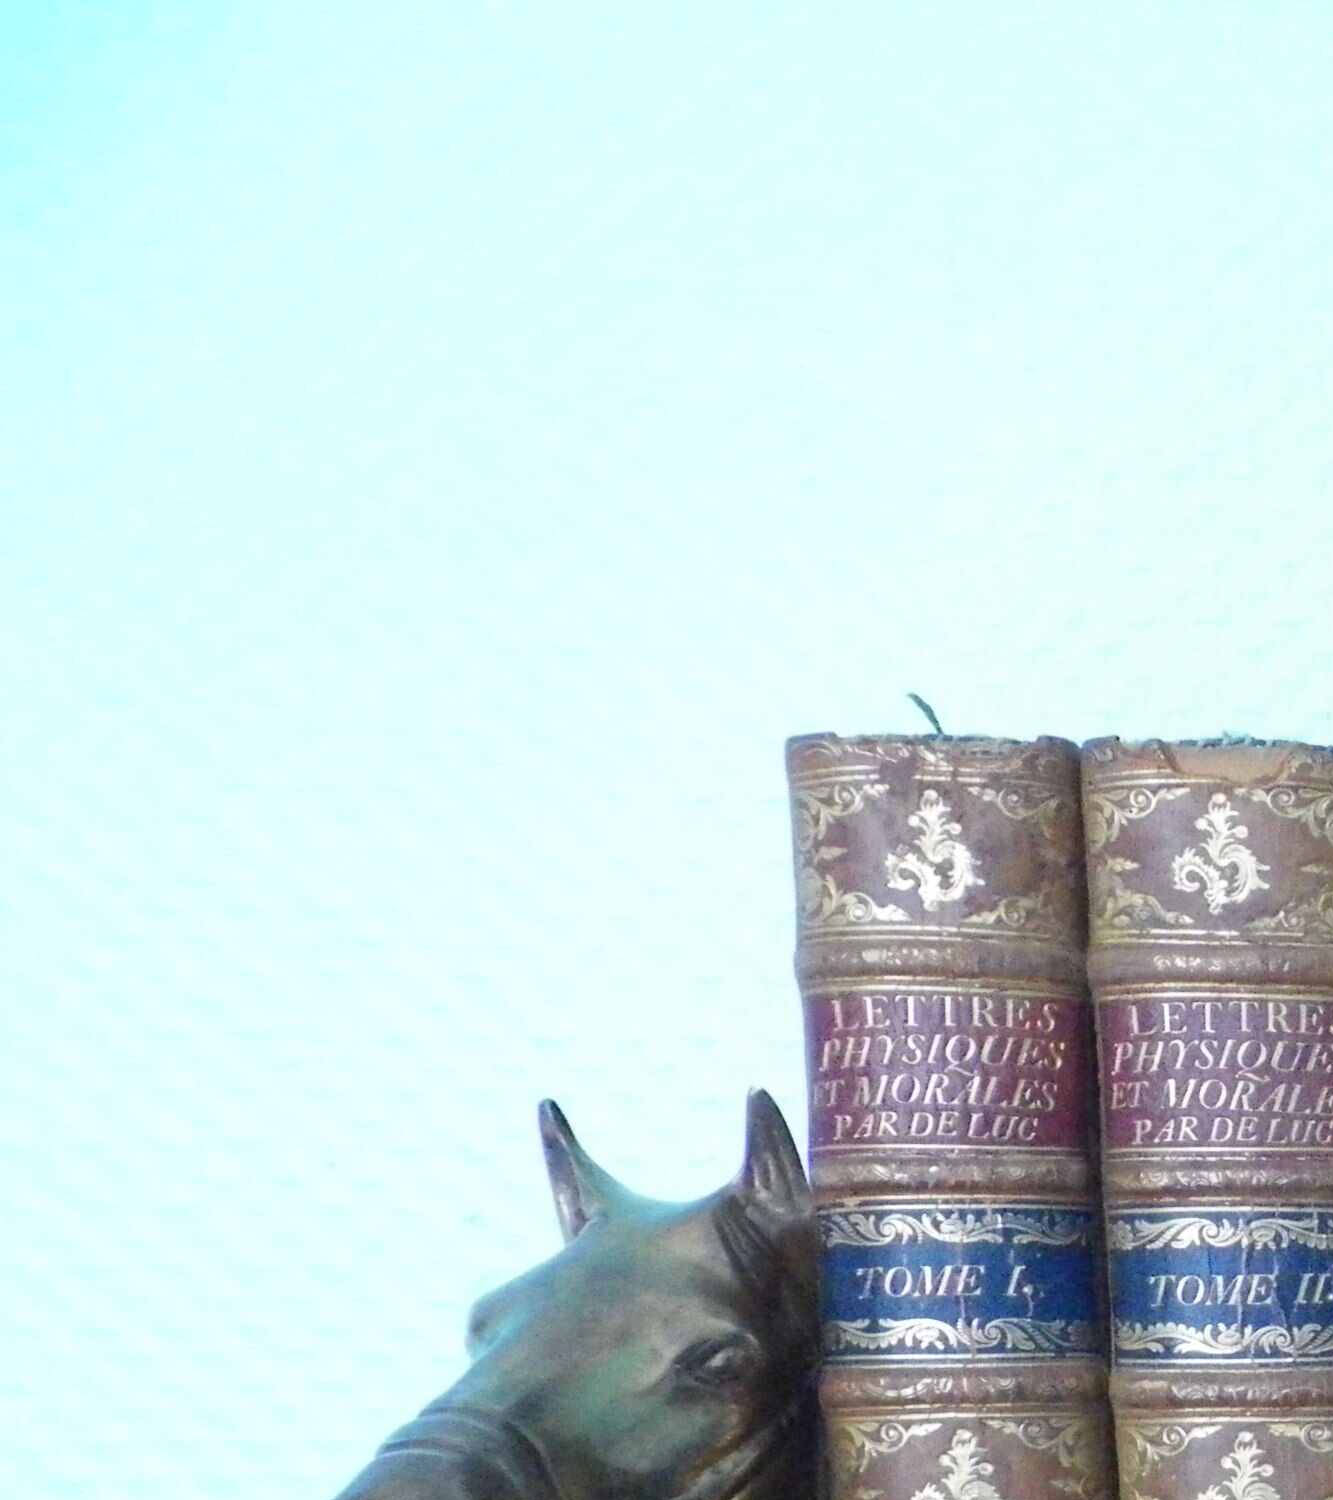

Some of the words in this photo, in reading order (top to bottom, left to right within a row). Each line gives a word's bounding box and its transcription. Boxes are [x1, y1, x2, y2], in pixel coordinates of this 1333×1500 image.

[831, 995, 1058, 1032] LETTRES
[819, 1034, 1066, 1076] PHYSIQUES
[854, 1073, 1059, 1111] MORALES
[1110, 1080, 1151, 1113] ET
[833, 1112, 898, 1140] PAR
[908, 1112, 960, 1137] DE
[967, 1113, 1039, 1140] LUC
[1132, 1117, 1200, 1144] PAR
[1208, 1116, 1258, 1142] DE
[1266, 1119, 1333, 1144] LUC
[855, 1265, 985, 1299] TOME
[1146, 1273, 1278, 1307] TOME
